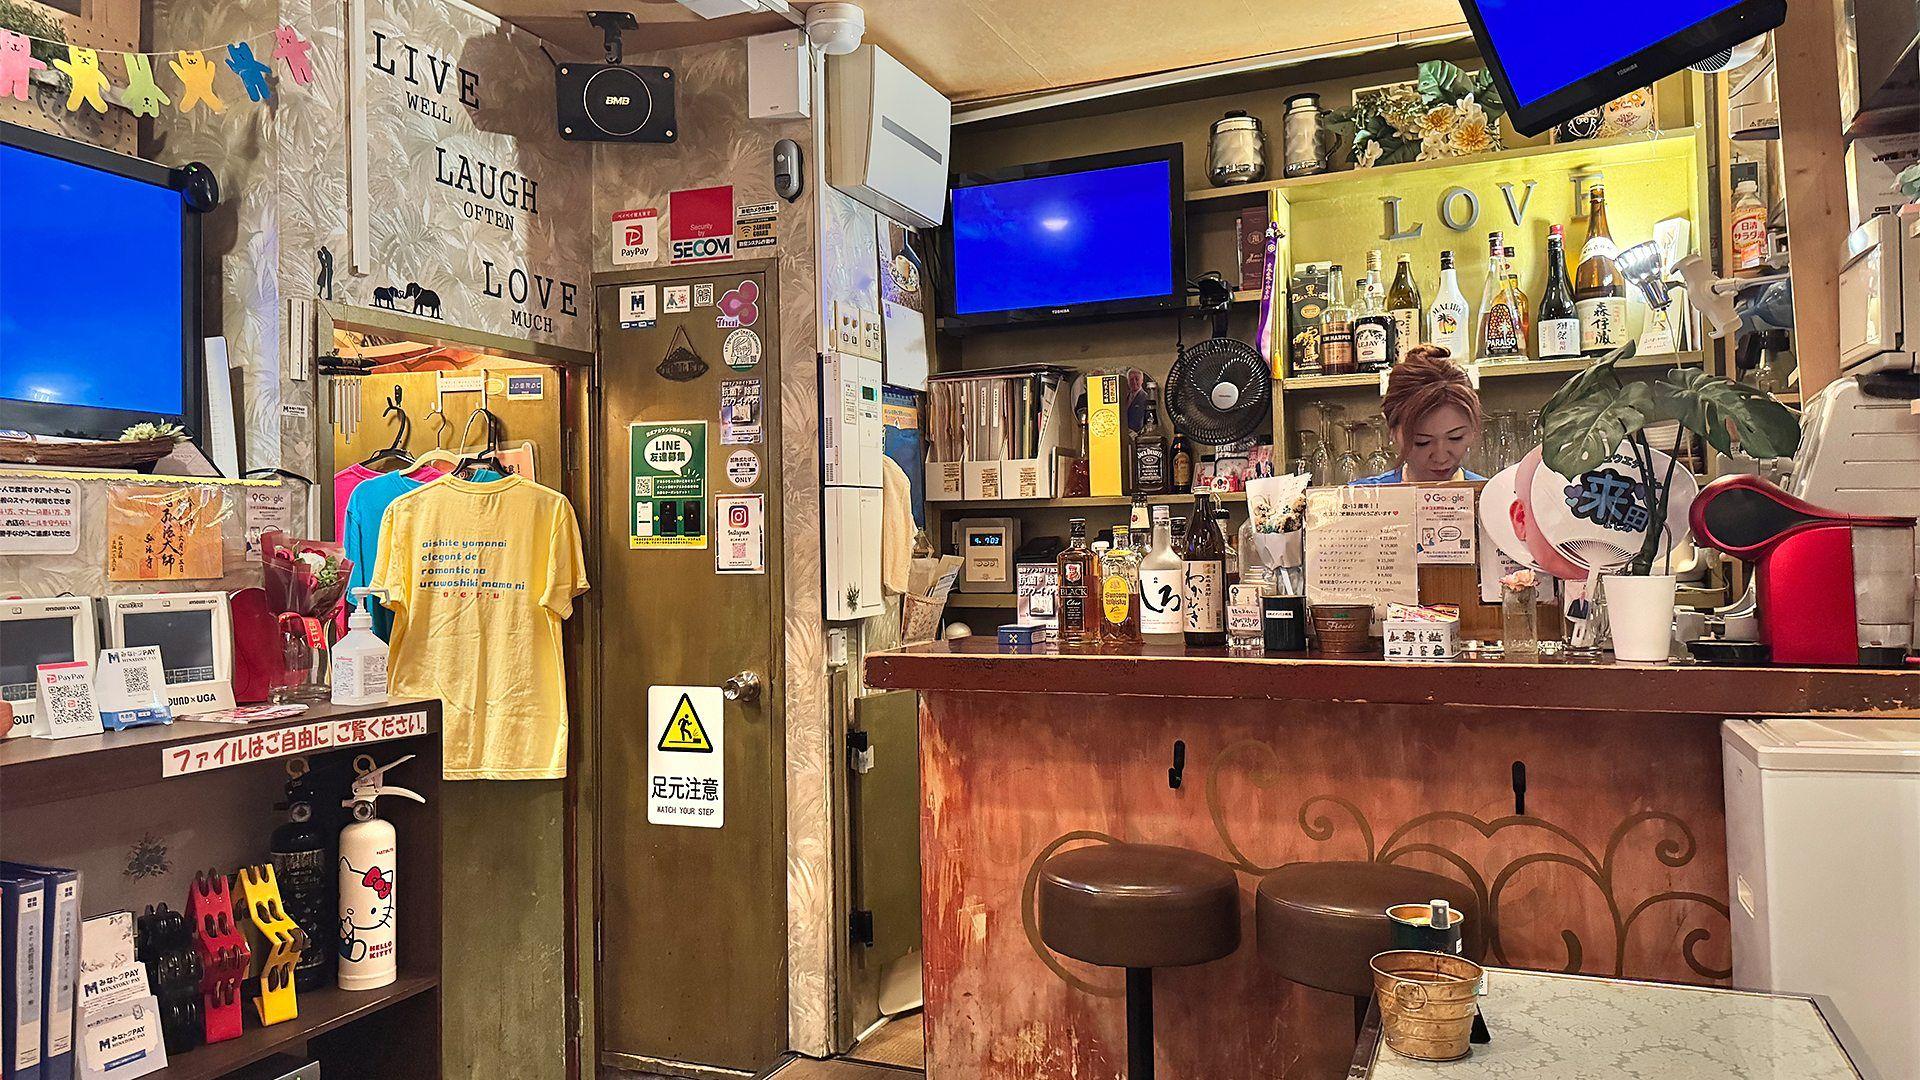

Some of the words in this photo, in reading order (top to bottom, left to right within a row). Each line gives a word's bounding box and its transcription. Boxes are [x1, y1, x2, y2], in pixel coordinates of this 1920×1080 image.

[372, 30, 480, 110] LIVE
[605, 95, 631, 106] BMB
[405, 90, 452, 124] WELL
[435, 146, 539, 215] LAUGH
[1378, 172, 1604, 241] LOVE
[464, 201, 514, 231] OFTEN
[690, 222, 713, 231] Security
[1741, 221, 1758, 231] 日清
[697, 230, 706, 238] by
[621, 246, 650, 258] PayPay
[673, 237, 730, 260] SECOM
[482, 260, 578, 317] LOVE
[511, 308, 553, 334] MUCH
[1487, 338, 1517, 348] PARAISO
[510, 381, 541, 390] JASRAC
[655, 440, 681, 452] LINE
[650, 451, 686, 463] 友達募集
[734, 476, 752, 484] ONLY
[258, 492, 283, 505] Gogle
[422, 540, 459, 549] aishite
[465, 552, 477, 561] de
[421, 566, 470, 575] romantic
[481, 580, 512, 589] mama
[515, 581, 525, 590] ni
[1060, 588, 1088, 596] BLACK
[1140, 579, 1181, 614] しろ
[57, 672, 85, 682] PayPay
[173, 724, 329, 773] ファイルはご自由に
[336, 714, 427, 743] ご覧ください。
[651, 775, 719, 801] 足元注意
[657, 805, 677, 815] WATCH
[679, 806, 696, 816] YOUR
[698, 807, 715, 816] STEP
[369, 940, 393, 952] HELLO
[369, 948, 393, 960] KITTY
[99, 968, 139, 987] みなトクPAY
[111, 1025, 145, 1042] みなトクPAY
